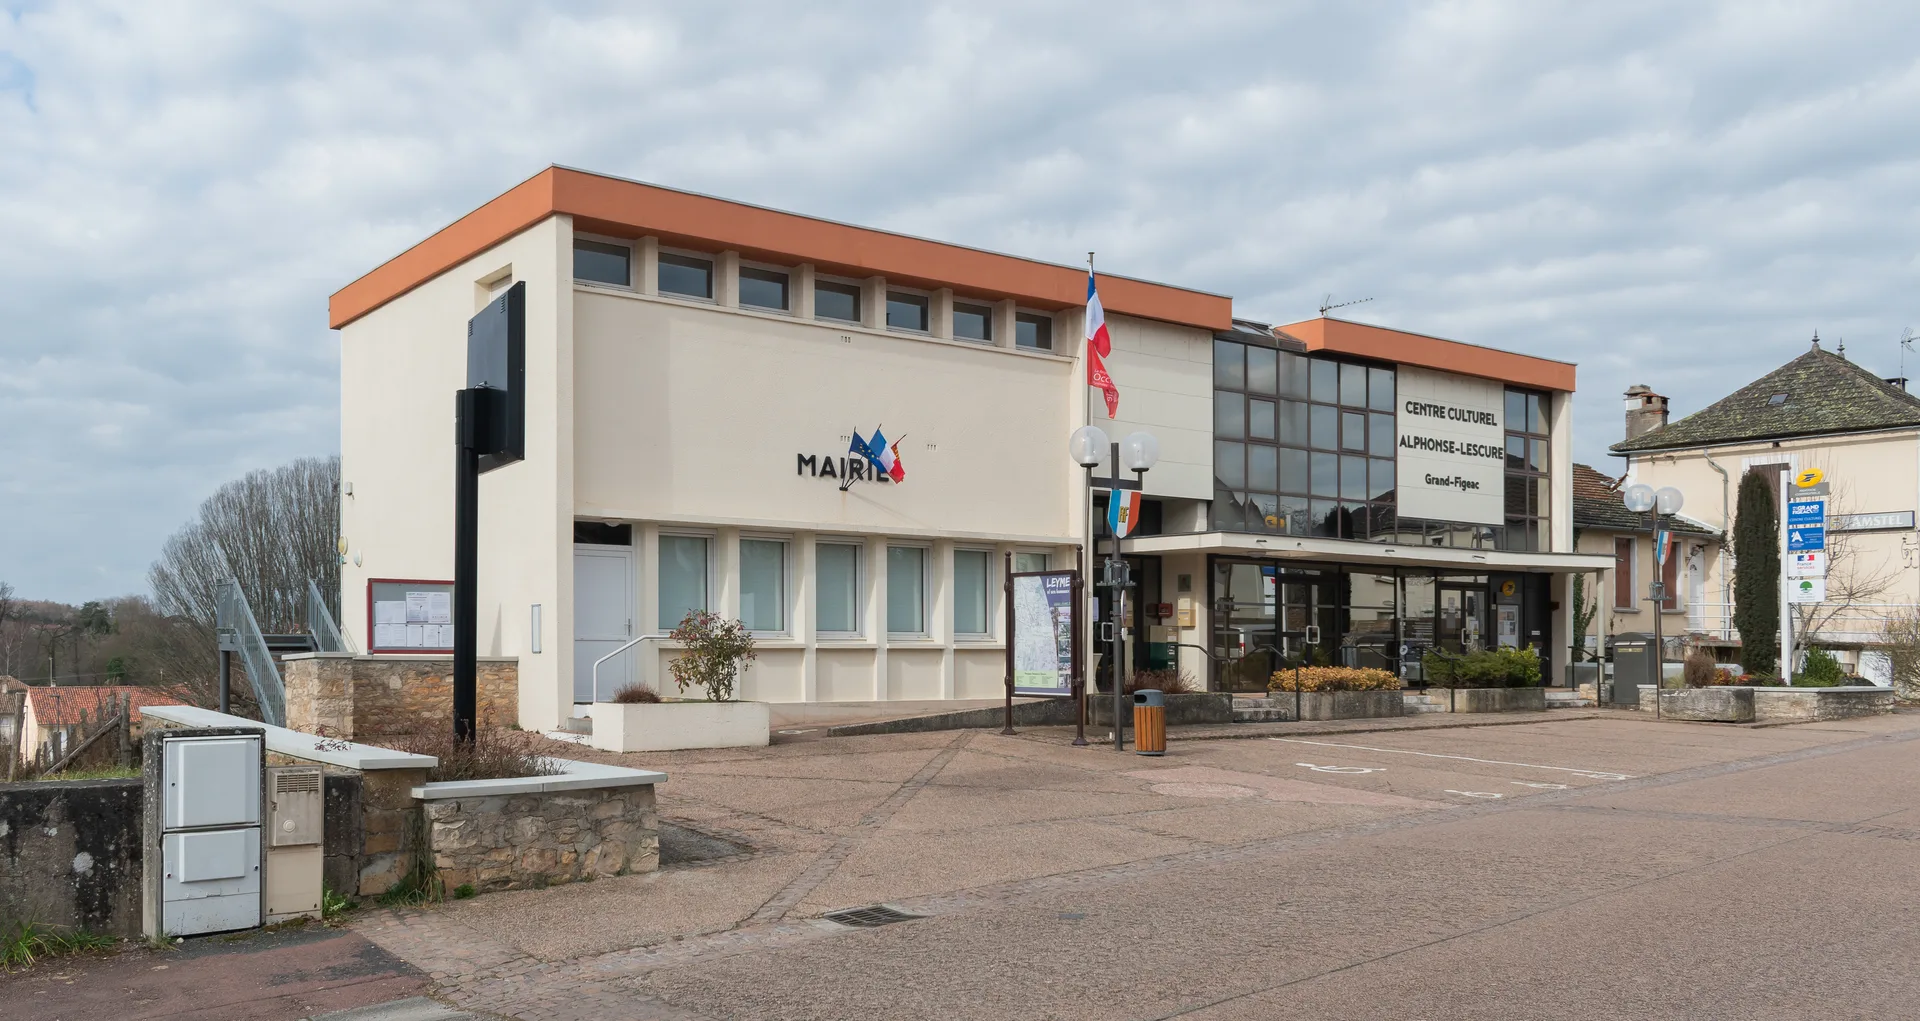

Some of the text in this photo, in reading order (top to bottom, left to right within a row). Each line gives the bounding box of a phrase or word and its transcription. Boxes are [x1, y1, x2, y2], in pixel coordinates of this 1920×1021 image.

[1405, 401, 1498, 426] CENTRE CULTUREL
[1399, 434, 1504, 460] ALPHONSE-LESCURE
[1425, 473, 1480, 491] Grand-Figeac
[1852, 515, 1903, 527] AMSTEL
[1046, 577, 1070, 588] LEYME
